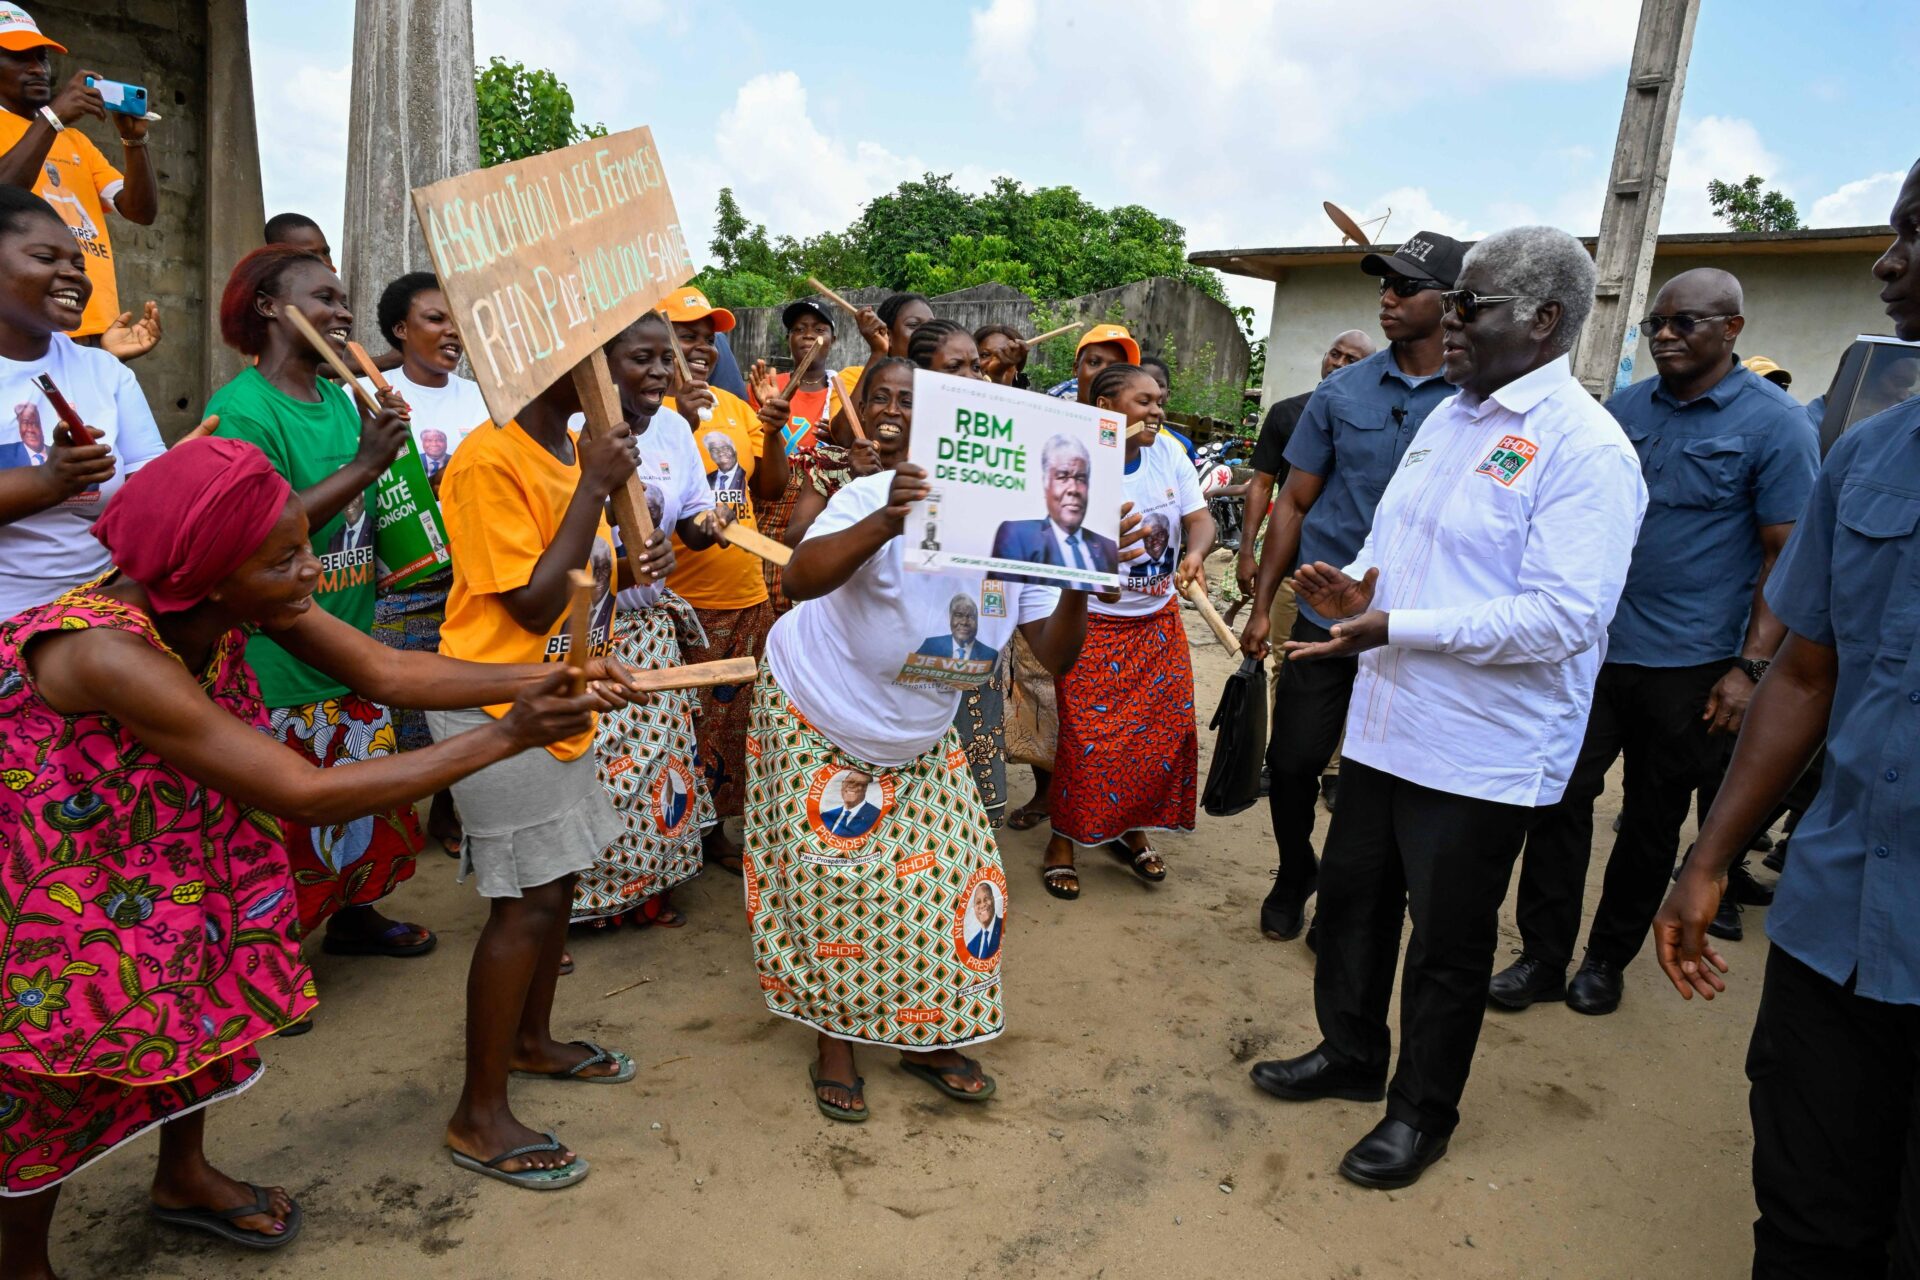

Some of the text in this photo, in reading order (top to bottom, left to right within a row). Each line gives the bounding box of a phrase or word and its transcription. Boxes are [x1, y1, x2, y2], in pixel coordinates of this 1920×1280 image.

[560, 159, 603, 226] DES
[472, 265, 565, 388] RHDP
[955, 408, 1013, 442] RBM
[937, 434, 1026, 473] DÉPUTÉ
[1500, 438, 1536, 455] RHDP
[935, 464, 1026, 491] DE SONGON
[715, 490, 742, 503] GRE
[320, 547, 372, 571] BEUGRE
[317, 561, 375, 593] MAM
[983, 580, 1003, 591] RH
[904, 666, 951, 679] ROBERT
[914, 655, 987, 674] JE VOTE
[747, 740, 761, 755] DP
[809, 774, 829, 802] AVEC
[653, 797, 661, 817] AVEC
[815, 824, 875, 849] PRESIDENT
[896, 854, 934, 875] RHDP
[954, 912, 965, 939] AVEC
[819, 944, 861, 956] RHDP
[900, 1010, 940, 1021] RHDP
